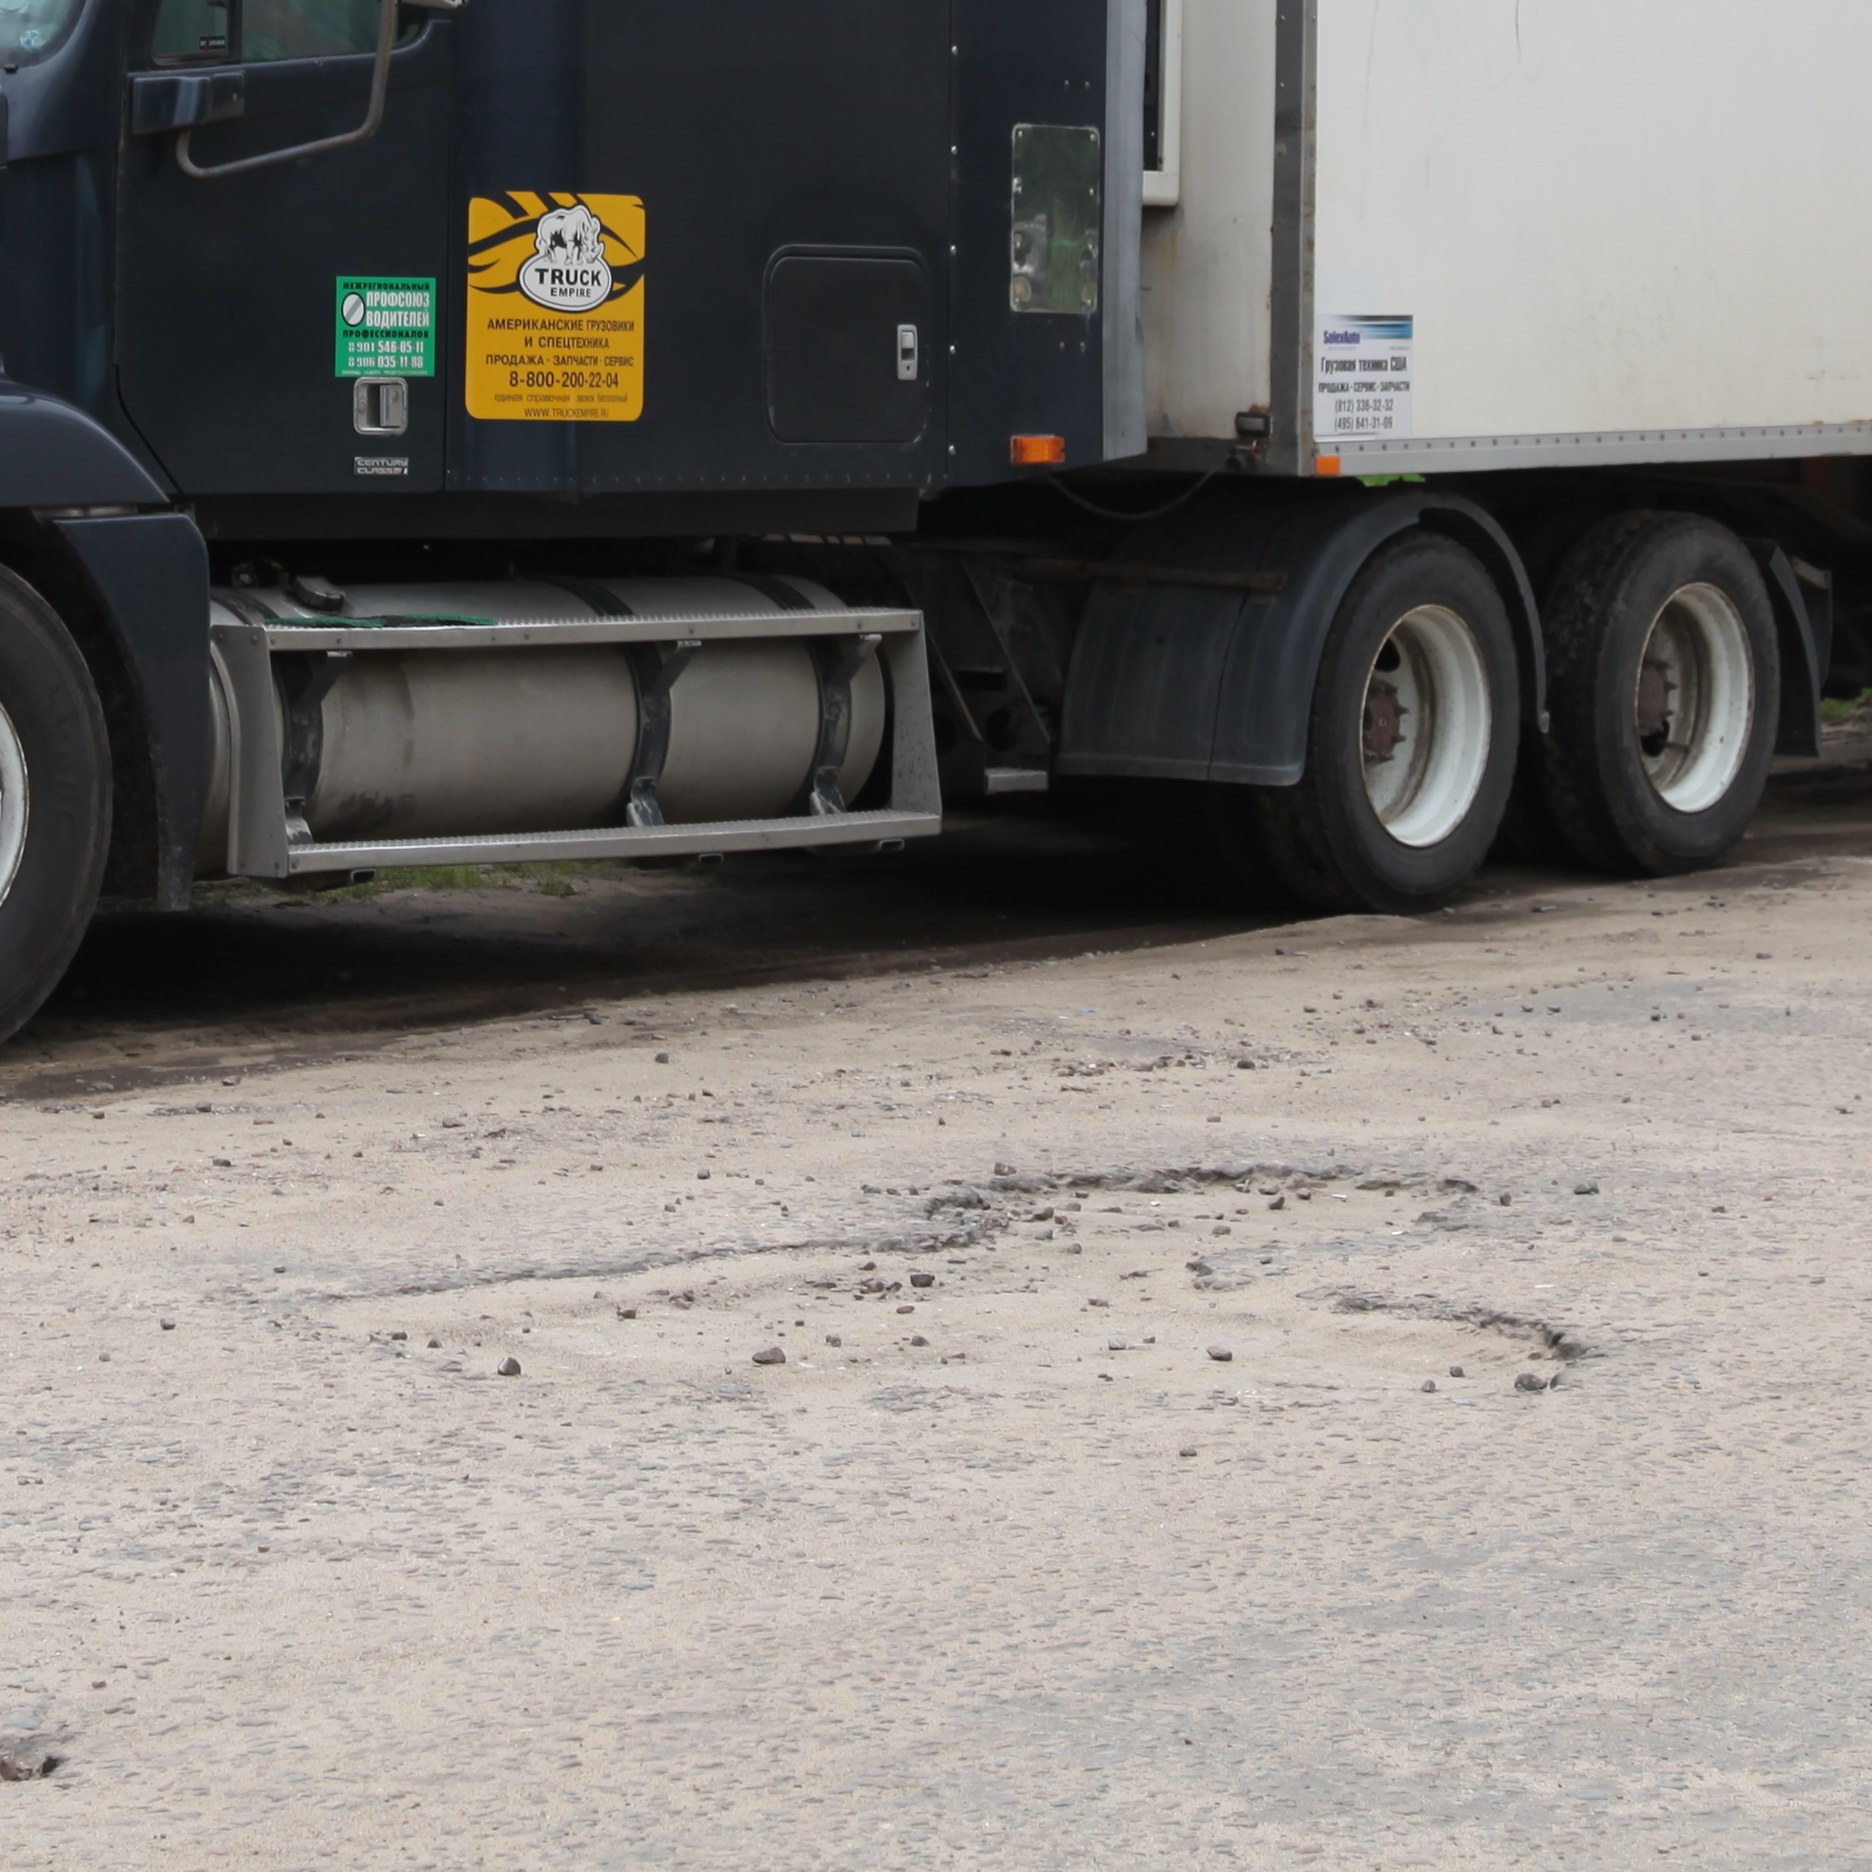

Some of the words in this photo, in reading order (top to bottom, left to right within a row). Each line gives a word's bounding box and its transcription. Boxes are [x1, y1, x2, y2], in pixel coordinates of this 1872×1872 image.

[534, 268, 602, 287] TRUCK
[342, 282, 430, 291] МЕЖРЕГИОНАЛЬНЫЙ
[550, 287, 592, 298] EMPIRE
[366, 291, 430, 308] ПРОФСОЮЗ
[366, 309, 430, 329] ВОДИТЕЛЕЙ
[487, 318, 584, 332] АМЕРИКАНСКИЕ
[586, 319, 635, 332] ГРУЗОВИКИ
[342, 330, 429, 339] ПРОФЕССИОНАЛОВ
[524, 336, 533, 348] И
[538, 336, 610, 350] СПЕЦТЕХНИКА
[486, 354, 544, 367] ПРОДАЖА
[553, 355, 599, 367] ЗАПЧАСТИ
[603, 356, 634, 367] СЕРВИС
[1321, 357, 1357, 374] Грузовая
[509, 371, 619, 388] 8-800-200-22-04
